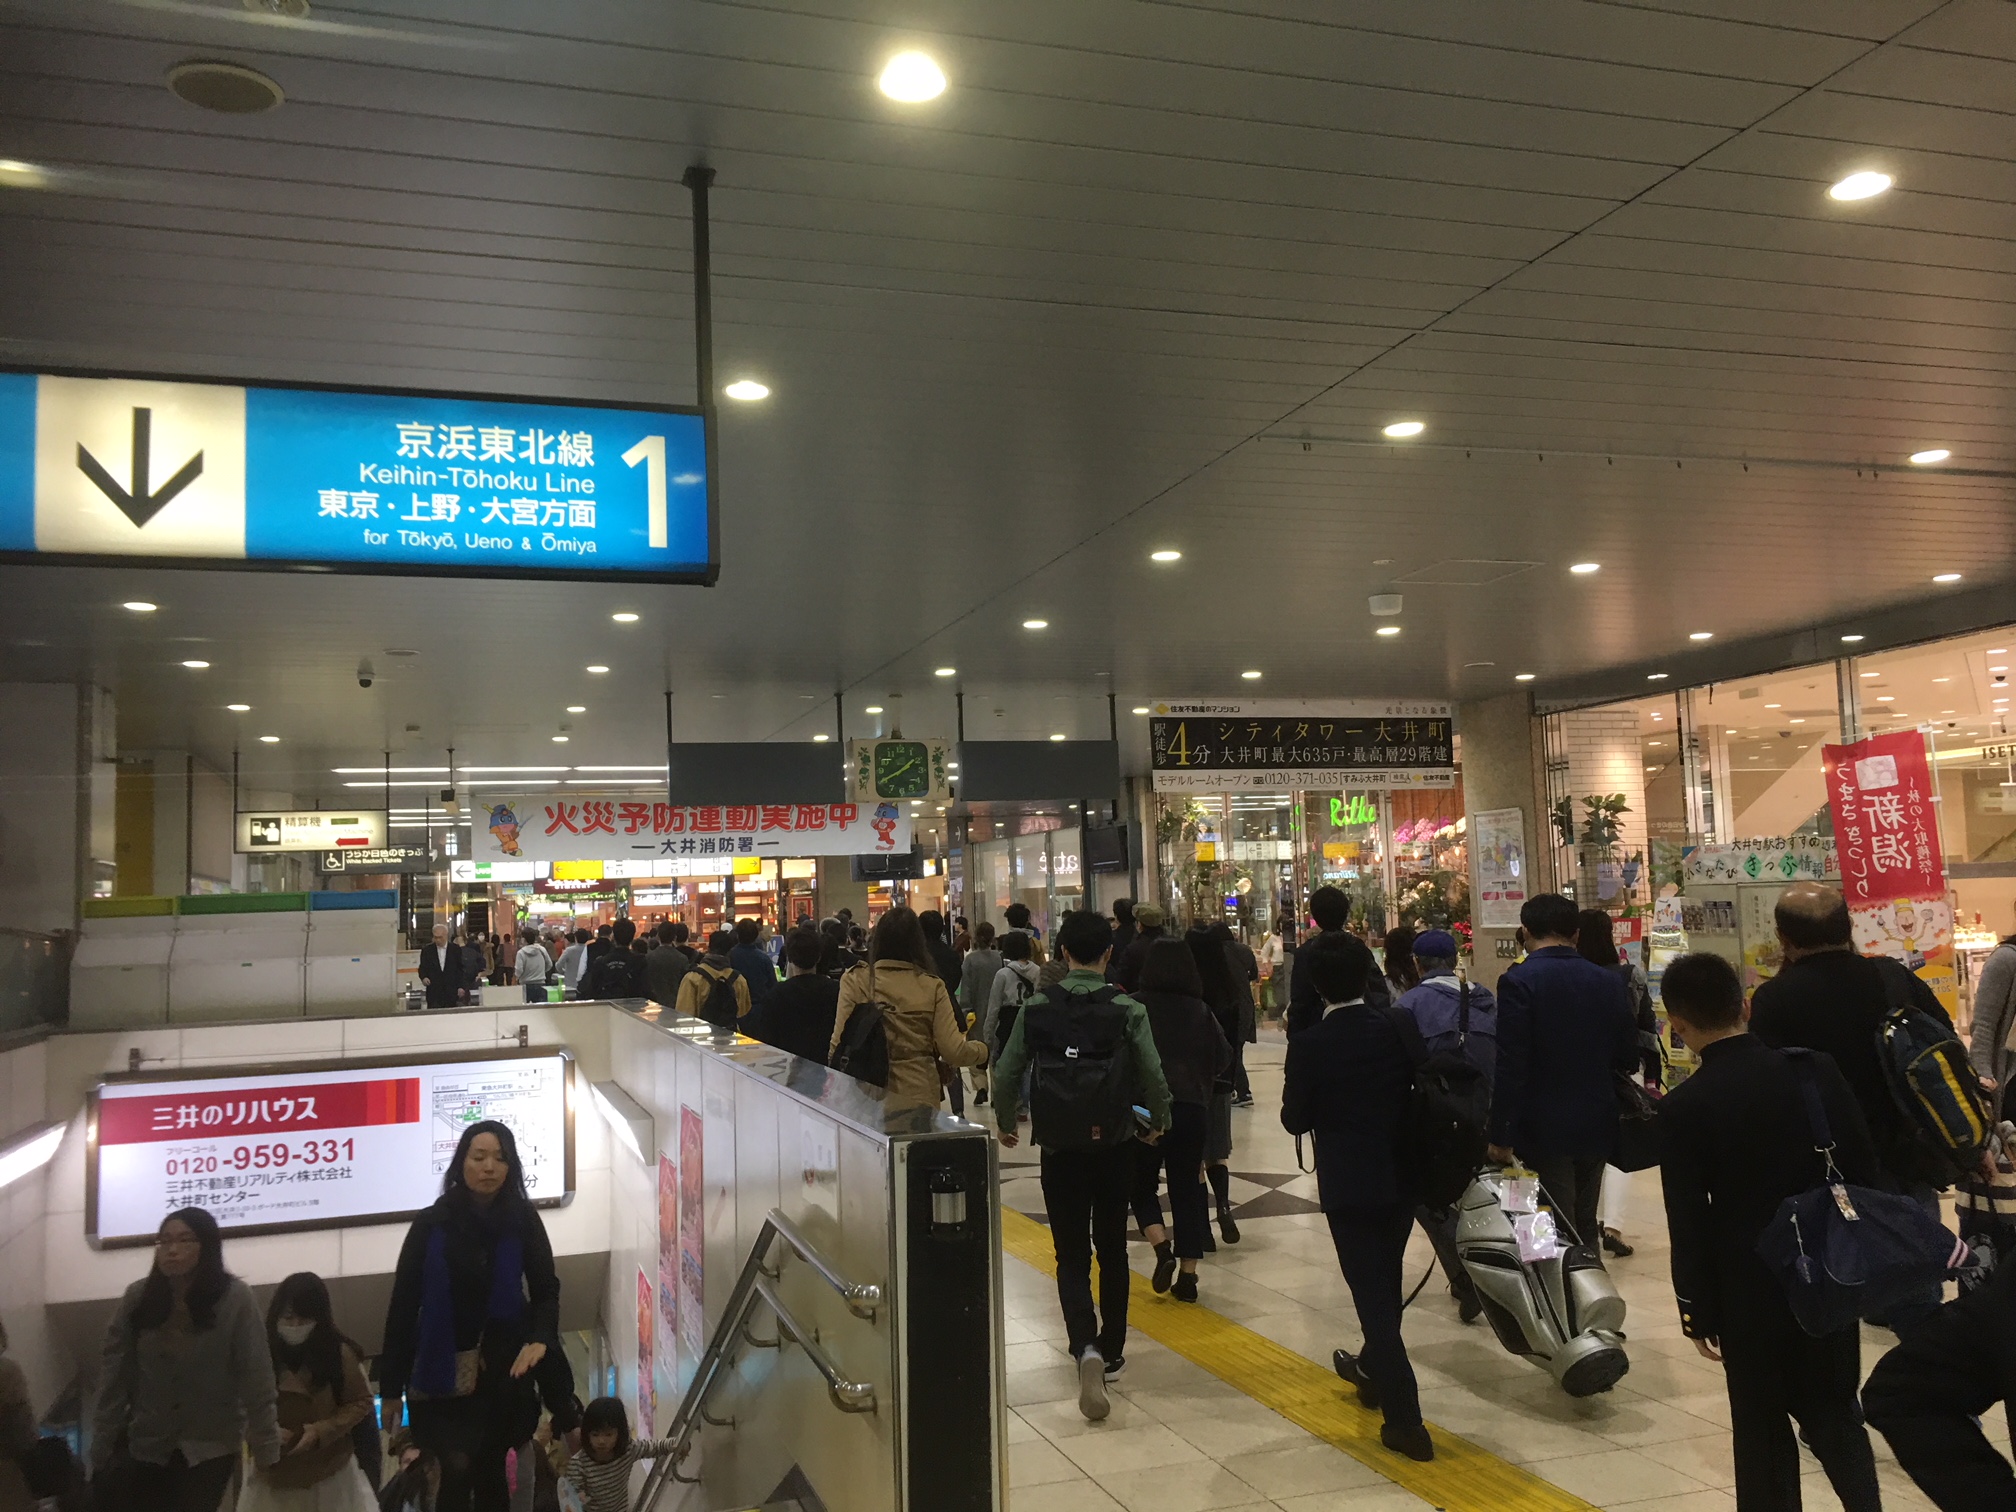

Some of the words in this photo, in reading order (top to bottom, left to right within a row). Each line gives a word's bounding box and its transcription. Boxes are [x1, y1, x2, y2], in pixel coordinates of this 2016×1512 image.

[396, 422, 595, 467] 京浜東北線
[359, 463, 538, 491] Keihin-Tōhoku
[546, 472, 595, 494] Line
[621, 435, 667, 548] 1
[317, 488, 597, 528] 東京・上野・大宮方面
[363, 528, 389, 545] for
[397, 529, 457, 551] Tōkyō,
[464, 533, 513, 550] Ueno
[521, 537, 532, 550] &
[541, 532, 597, 555] Ōmiya
[1154, 722, 1167, 766] 駅徒歩
[1219, 721, 1446, 743] シティタワー大井町
[1157, 774, 1251, 786] モデルルームオープン
[1264, 771, 1338, 786] 0120-371-035
[543, 801, 859, 835] 火災予防運動実施中
[1330, 795, 1376, 826] Rilke
[151, 1096, 318, 1132] 三井のリハウス
[166, 1145, 217, 1156] フリーコール
[165, 1166, 354, 1194] 三井不動産リアルティ株式会社
[165, 1190, 260, 1209] 大井町センター
